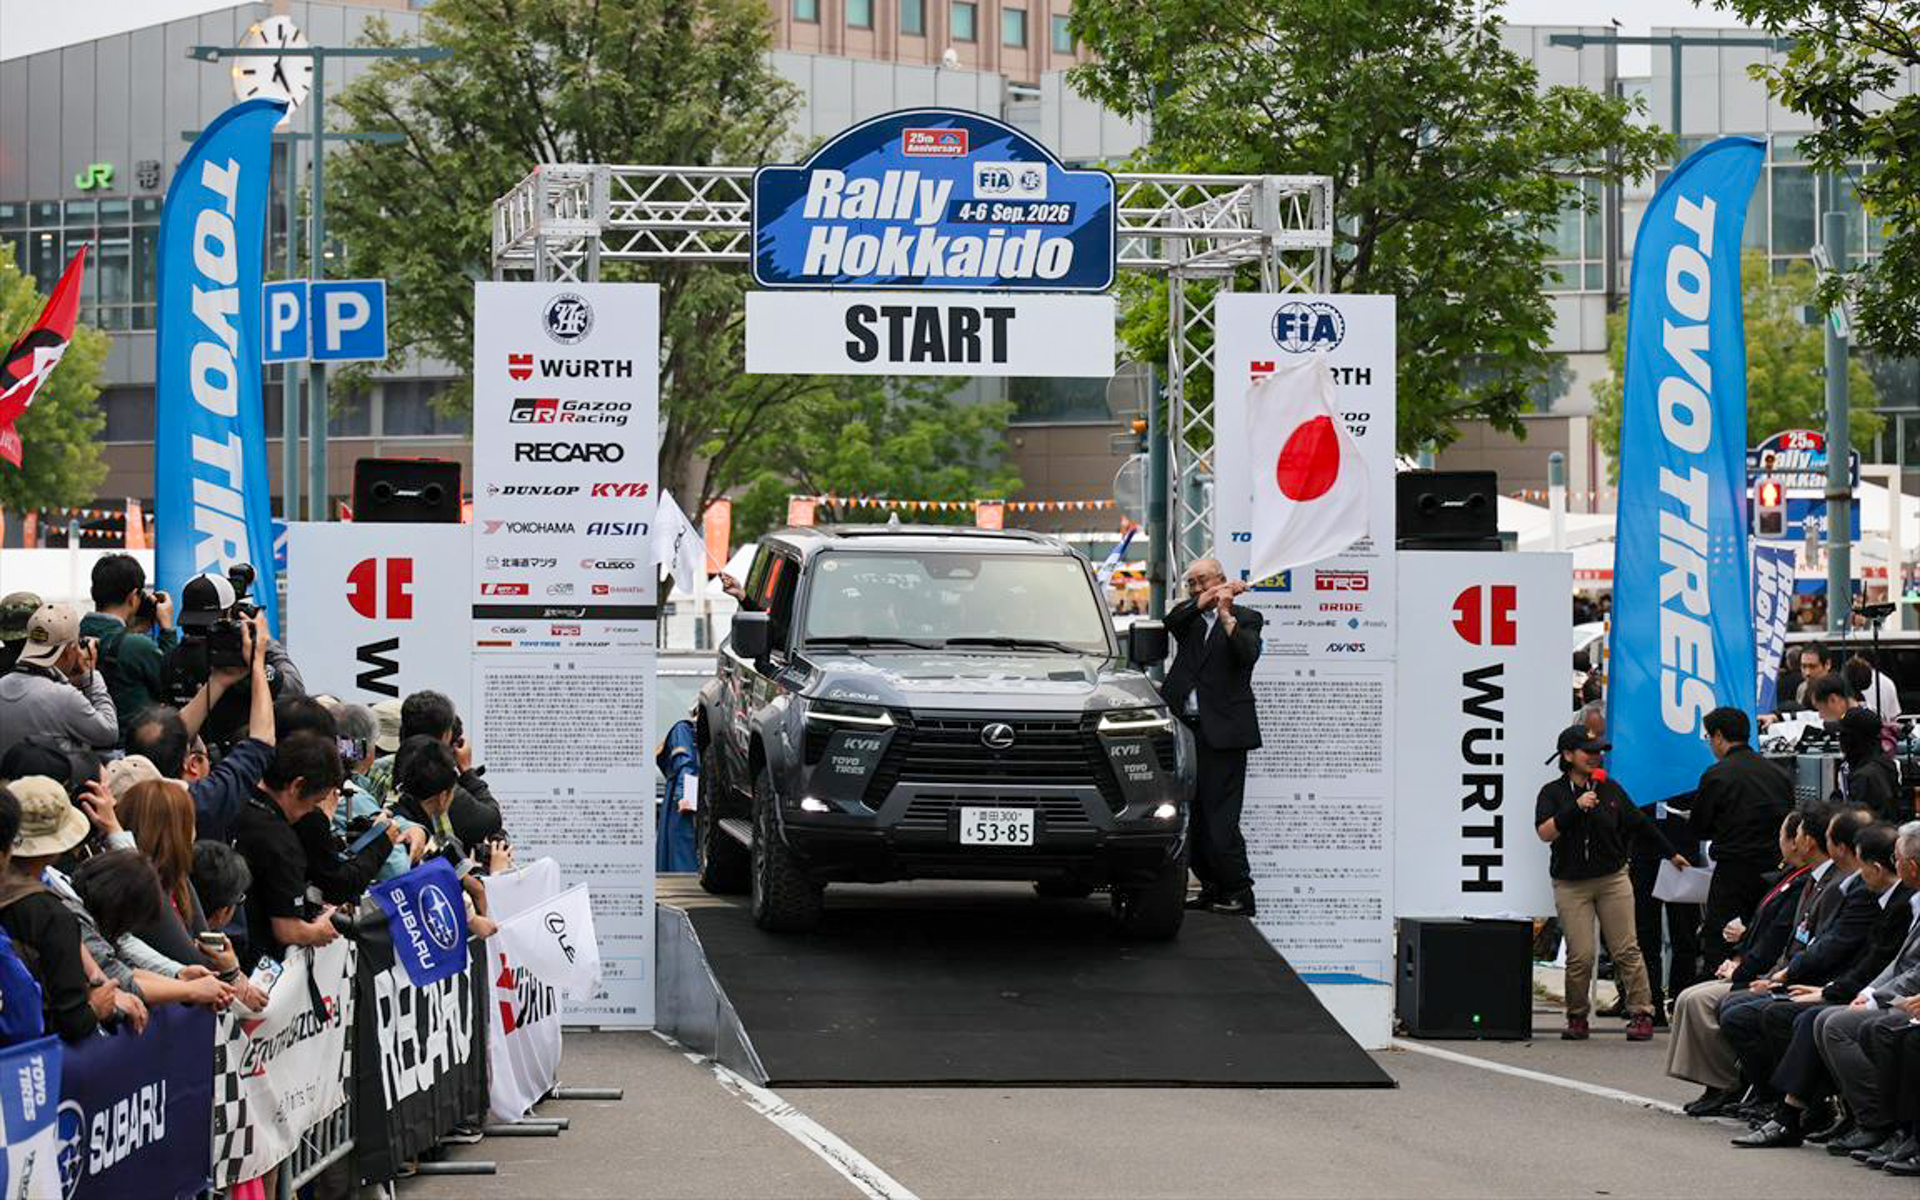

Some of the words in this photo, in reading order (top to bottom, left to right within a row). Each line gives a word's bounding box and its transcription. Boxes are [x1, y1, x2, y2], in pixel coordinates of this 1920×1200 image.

[74, 163, 114, 190] JR
[803, 168, 953, 226] Rally
[959, 202, 987, 221] 4-6
[803, 226, 1074, 280] Hokkaido
[190, 157, 240, 417] TOYO
[271, 292, 300, 352] P
[324, 291, 371, 351] P
[845, 304, 1016, 363] START
[1658, 195, 1717, 453] TOYO
[510, 408, 556, 424] GR
[559, 413, 628, 427] Racing
[515, 442, 624, 463] RECARO
[502, 486, 580, 496] DUNLOP
[591, 482, 649, 498] KYB
[506, 522, 576, 534] YOKOHAMA
[586, 522, 649, 535] AISIN
[595, 561, 635, 570] CUSCO
[1659, 465, 1717, 740] TIRES
[844, 738, 881, 750] KYB
[1461, 662, 1504, 893] WÜRTH
[976, 823, 1029, 842] 53-85
[1000, 811, 1018, 822] 300
[390, 887, 435, 970] SUBARU
[18, 1066, 36, 1122] TIRES
[30, 1055, 46, 1106] TOYO
[89, 1079, 166, 1176] SUBARU
